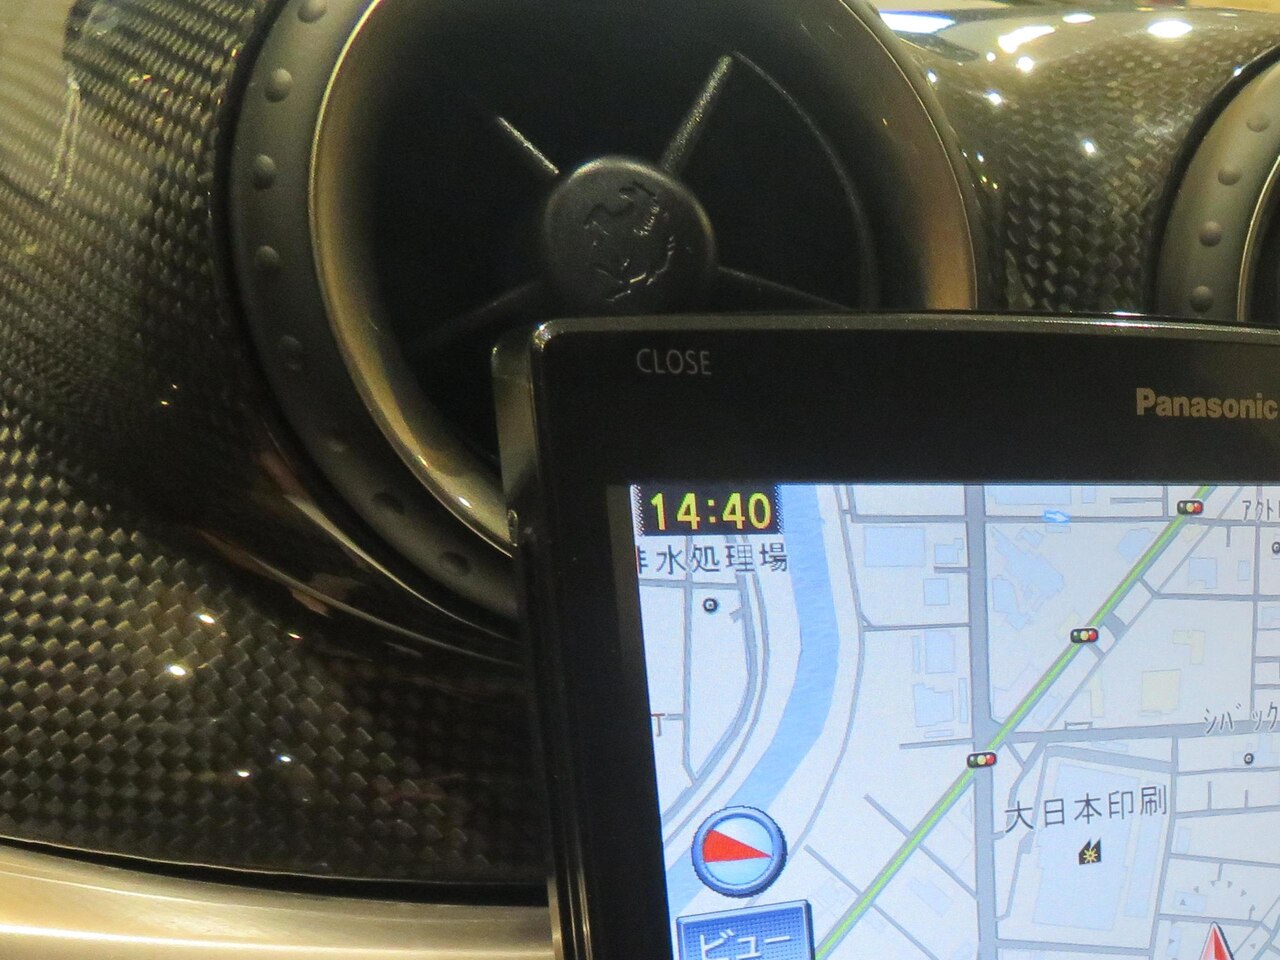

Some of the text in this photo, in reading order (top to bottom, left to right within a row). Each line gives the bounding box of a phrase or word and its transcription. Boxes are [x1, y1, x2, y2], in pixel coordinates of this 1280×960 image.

[636, 348, 712, 375] CLOSE
[1135, 387, 1279, 420] Panasonic
[650, 492, 772, 530] 14:40
[1004, 784, 1168, 834] 大日本印刷
